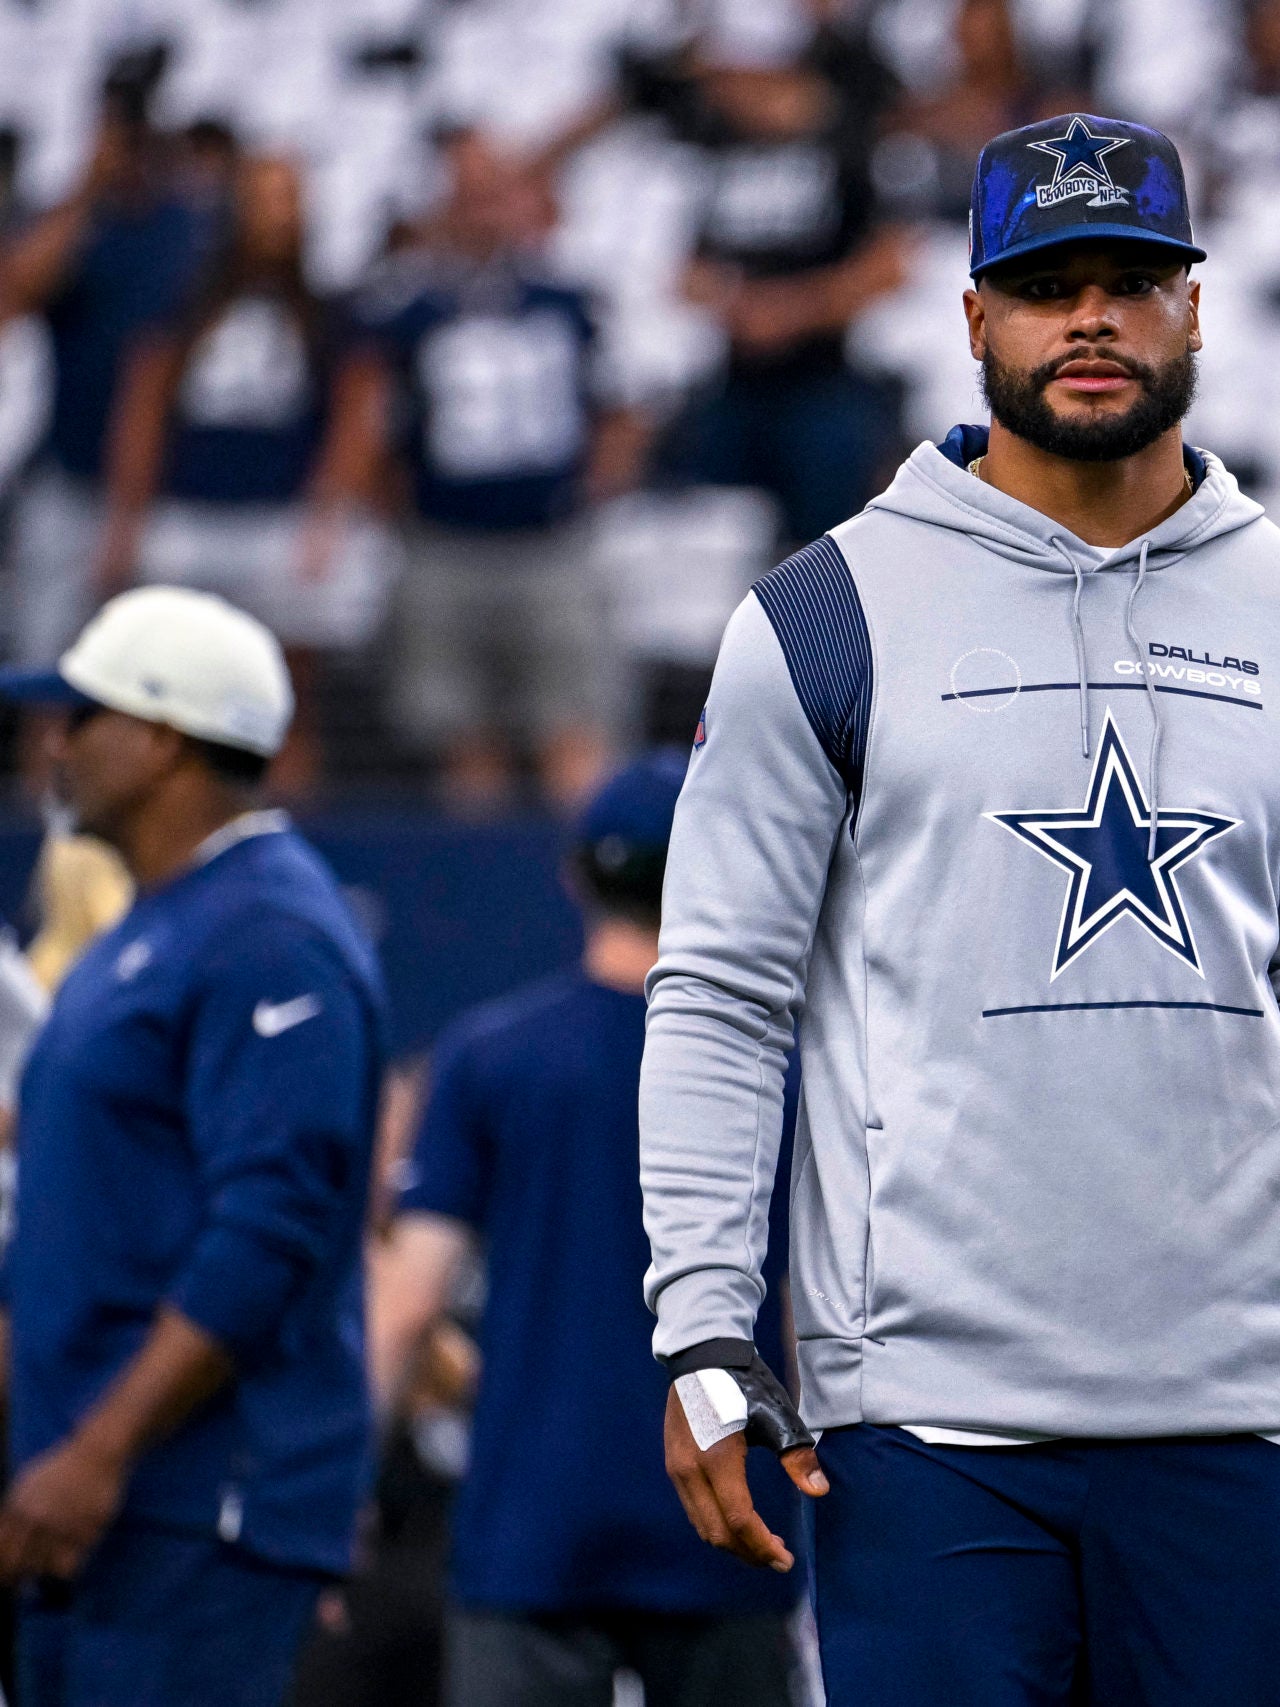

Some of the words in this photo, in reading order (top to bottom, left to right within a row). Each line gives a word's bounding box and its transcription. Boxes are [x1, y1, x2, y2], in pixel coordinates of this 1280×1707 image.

[1039, 180, 1095, 204] COWBOYS
[1100, 189, 1121, 202] NFC
[1149, 642, 1260, 676] DALLAS
[1113, 660, 1262, 695] COWBOYS
